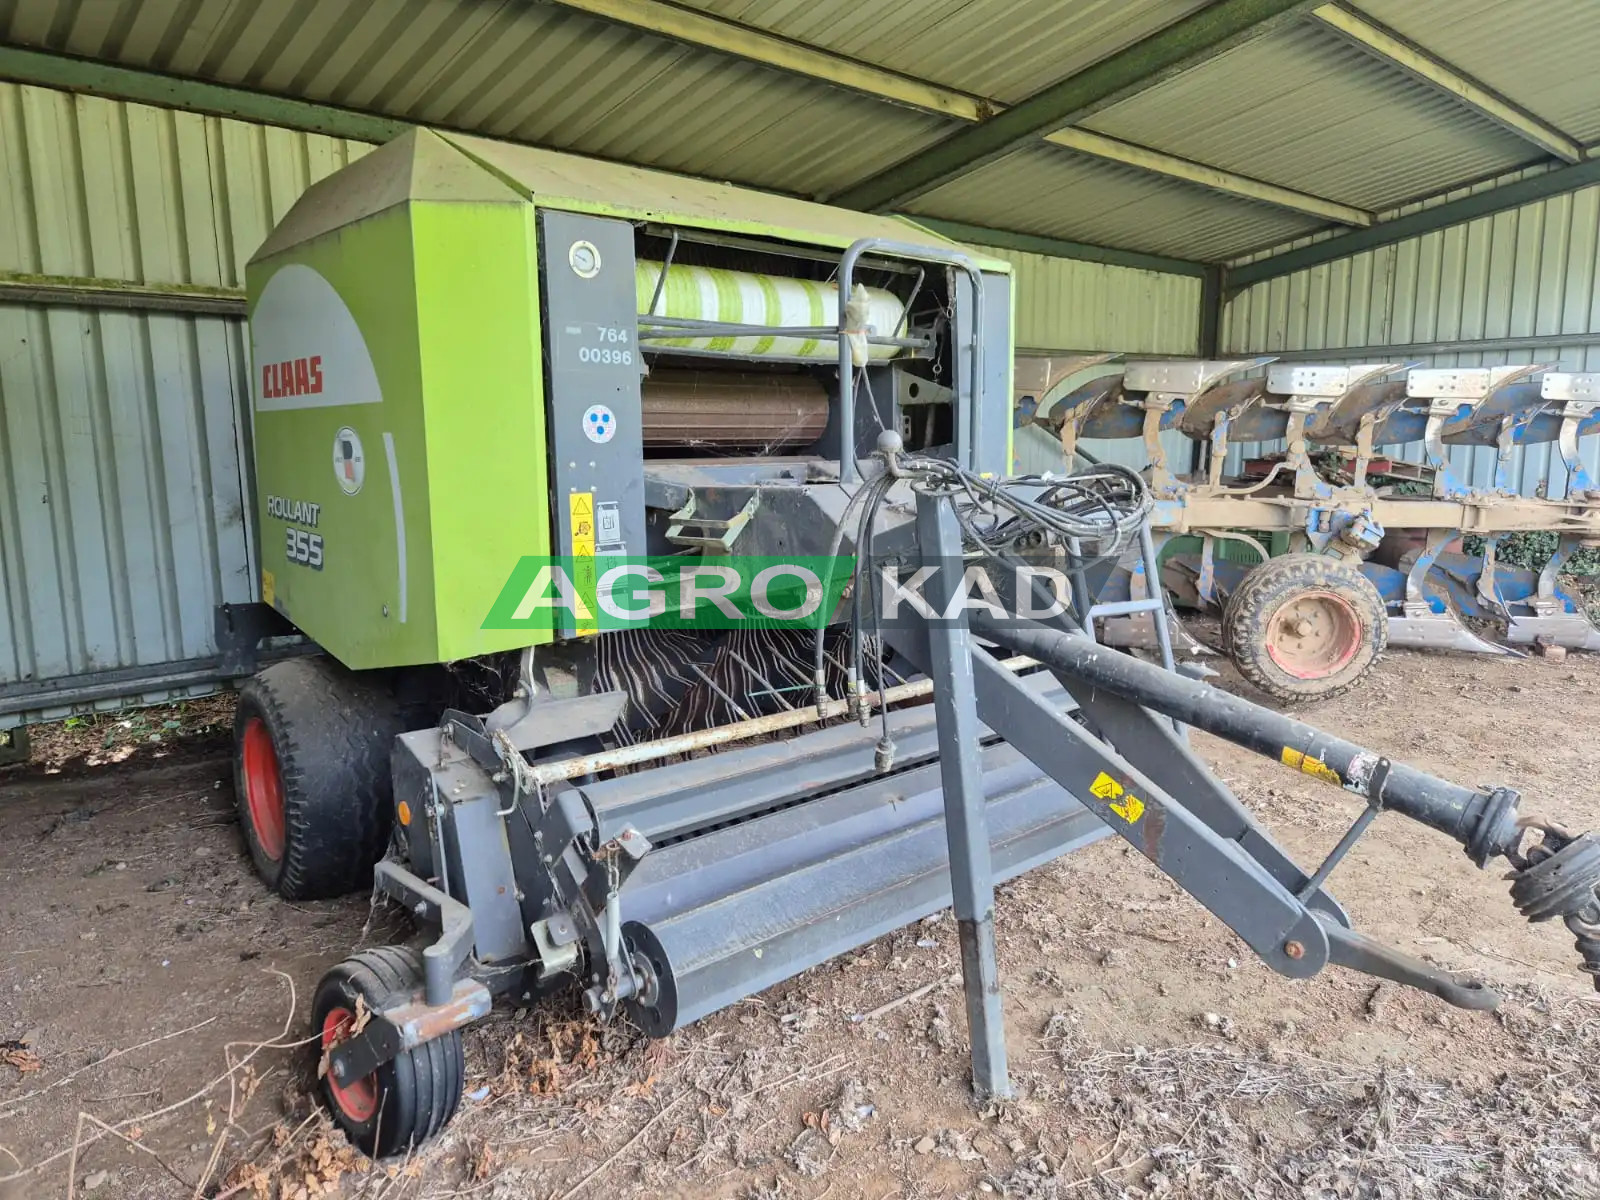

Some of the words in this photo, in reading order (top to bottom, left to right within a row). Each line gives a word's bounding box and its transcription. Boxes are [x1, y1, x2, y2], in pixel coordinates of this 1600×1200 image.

[597, 326, 628, 343] 764
[578, 346, 632, 365] 00396
[262, 356, 322, 398] CLAAS
[267, 495, 320, 527] ROLLANT
[286, 527, 324, 571] 355
